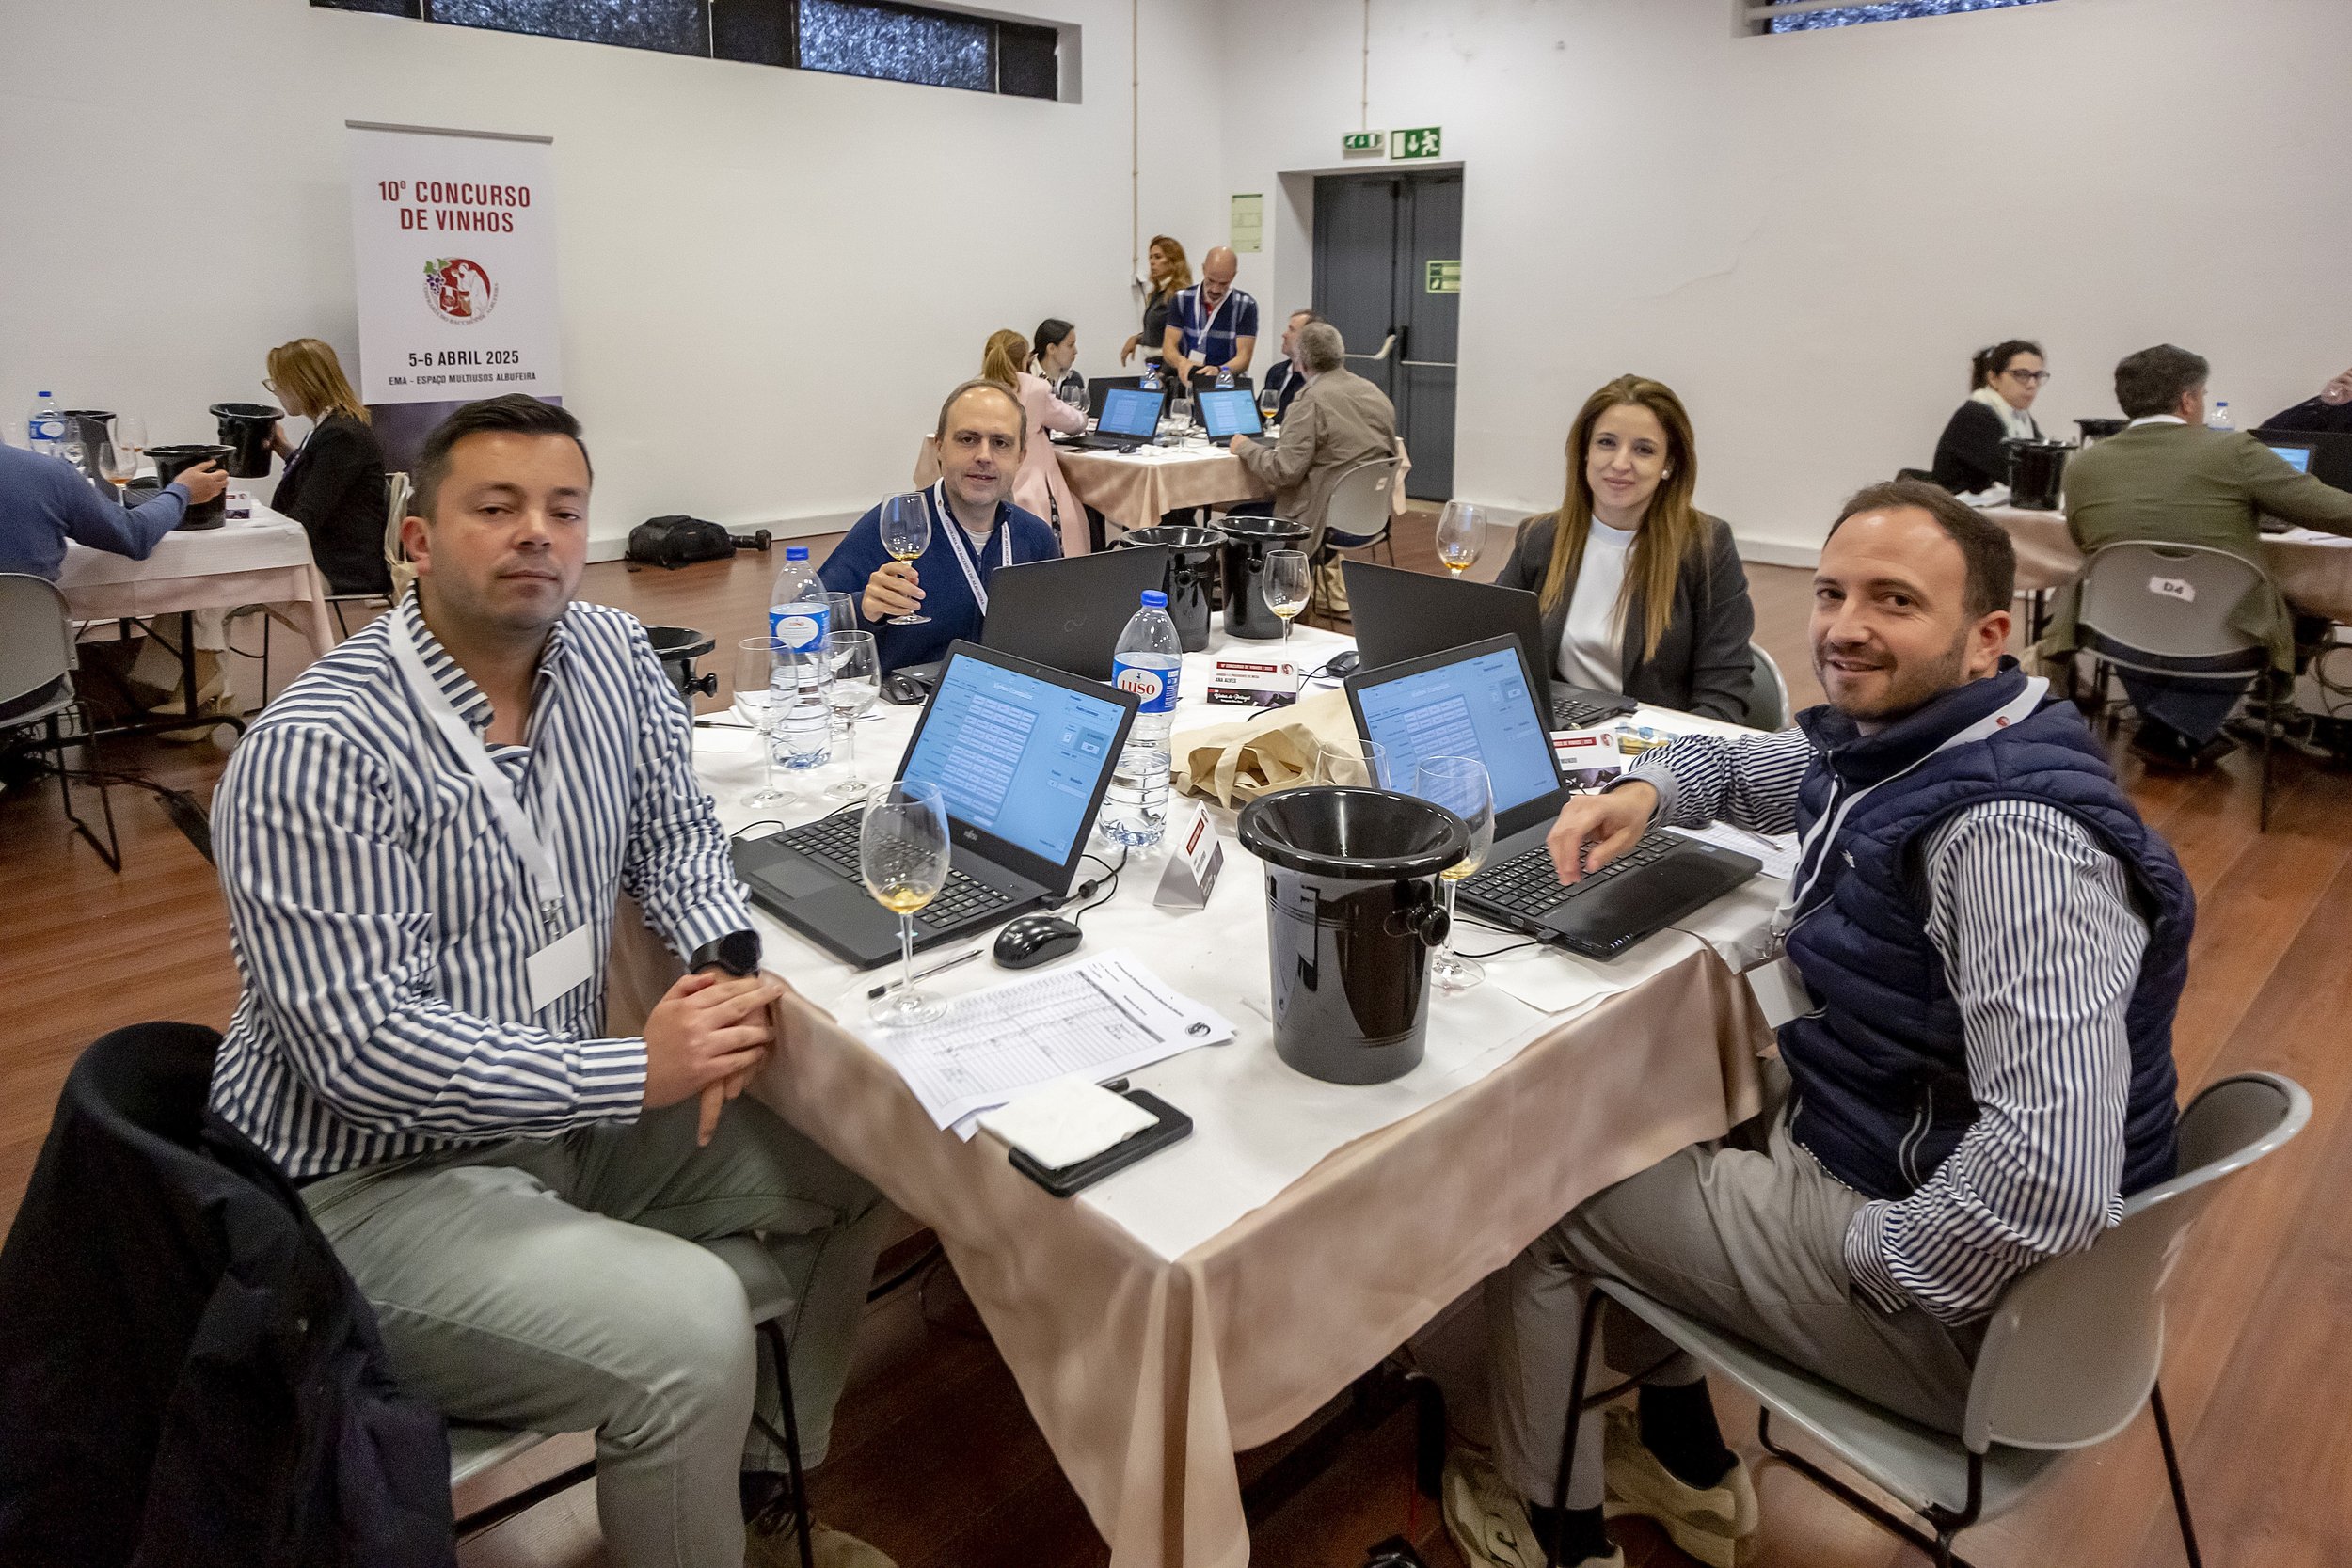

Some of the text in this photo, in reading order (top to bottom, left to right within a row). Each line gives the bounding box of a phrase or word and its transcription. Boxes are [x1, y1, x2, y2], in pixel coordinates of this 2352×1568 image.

[415, 181, 531, 208] CONCURSO
[400, 208, 514, 233] DE VINHOS
[408, 350, 519, 367] 5-6 ABRIL 2025
[389, 376, 407, 386] EMA
[416, 375, 446, 386] ESPAÇO
[449, 373, 493, 384] MULTIUSOS
[496, 372, 536, 382] ALBUFEIRA
[2164, 582, 2184, 594] D4
